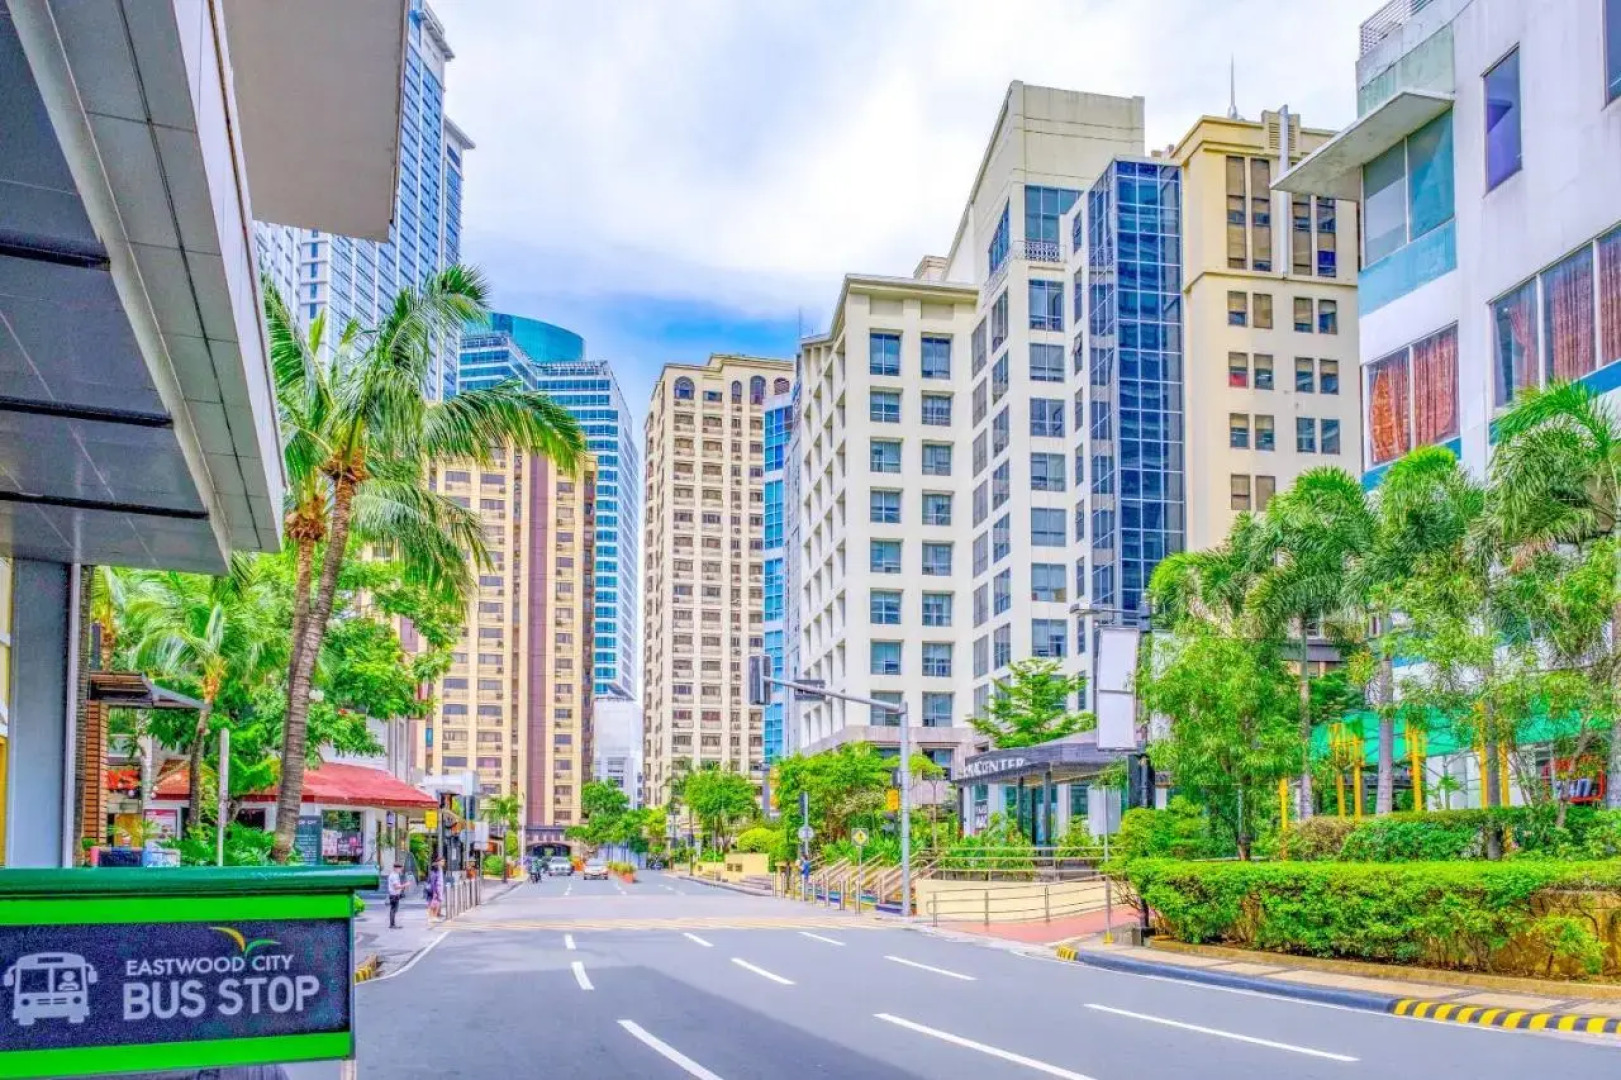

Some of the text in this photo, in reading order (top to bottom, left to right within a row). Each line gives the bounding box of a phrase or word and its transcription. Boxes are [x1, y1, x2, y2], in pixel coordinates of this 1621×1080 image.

[126, 955, 295, 976] EASTWOOD CITY
[123, 975, 320, 1021] BUS STOP
